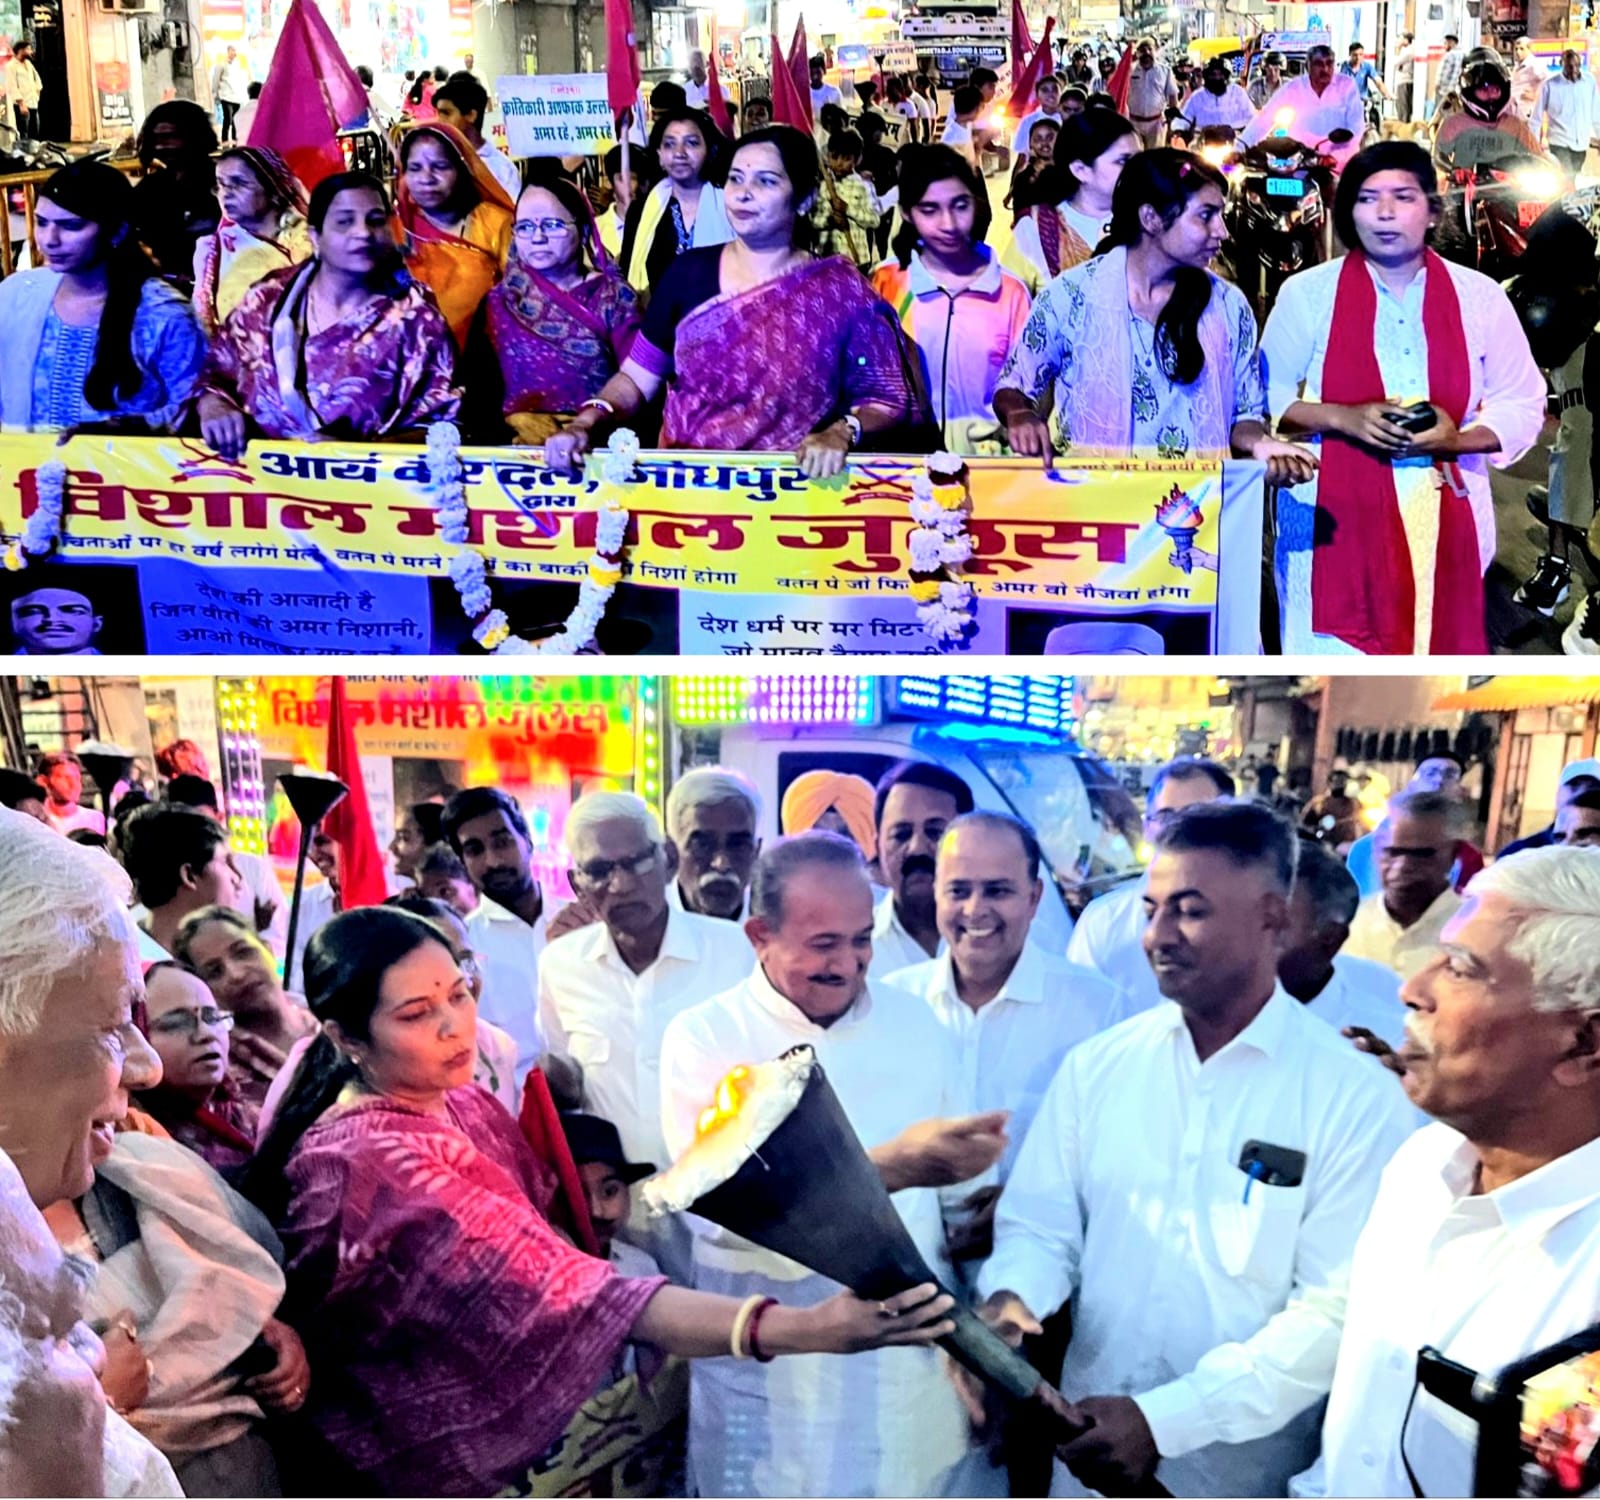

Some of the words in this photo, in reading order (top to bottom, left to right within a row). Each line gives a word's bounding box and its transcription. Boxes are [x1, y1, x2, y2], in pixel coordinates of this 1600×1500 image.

[533, 125, 557, 140] अमर
[575, 125, 599, 140] अमर
[259, 451, 383, 483] आर्य
[191, 540, 223, 558] वर्ष
[335, 549, 376, 564] वतन
[504, 560, 532, 573] का
[775, 576, 819, 590] वतन
[991, 581, 1038, 594] अमर
[269, 590, 353, 612] आजादी
[356, 589, 376, 613] है
[279, 618, 332, 636] अमर
[335, 616, 424, 640] निशानी,
[697, 611, 739, 635] देश
[746, 614, 785, 634] धर्म
[790, 619, 823, 636] पर
[828, 621, 863, 637] मर
